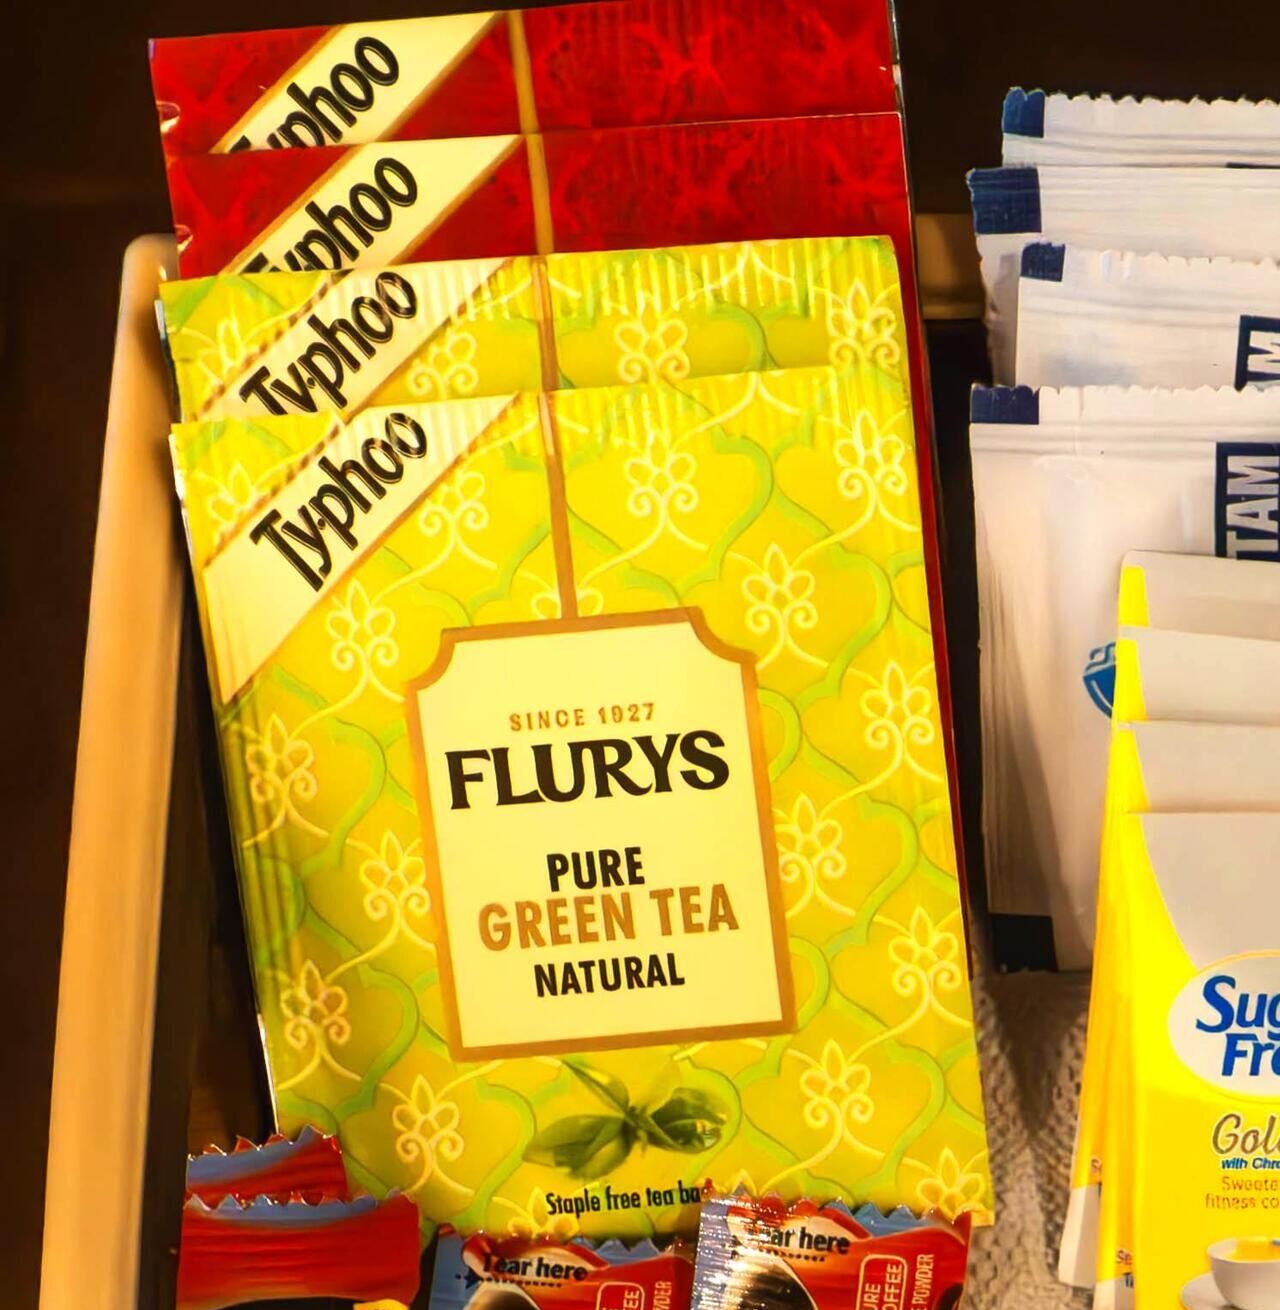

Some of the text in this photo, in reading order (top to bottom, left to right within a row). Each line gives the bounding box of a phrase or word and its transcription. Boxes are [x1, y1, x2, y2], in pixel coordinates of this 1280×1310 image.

[230, 37, 399, 151] phoo
[1226, 455, 1280, 559] TAM
[509, 703, 654, 732] SINCE 1927
[445, 730, 729, 810] FLURYS
[546, 847, 645, 892] PURE
[479, 884, 739, 951] GREEN TEA
[534, 953, 685, 997] NATURAL
[1221, 1158, 1248, 1170] with
[546, 1180, 704, 1219] Staple free tea ba
[1205, 1193, 1256, 1210] fitness
[799, 1226, 850, 1255] here
[536, 1256, 588, 1281] here
[912, 1253, 934, 1304] POWDER
